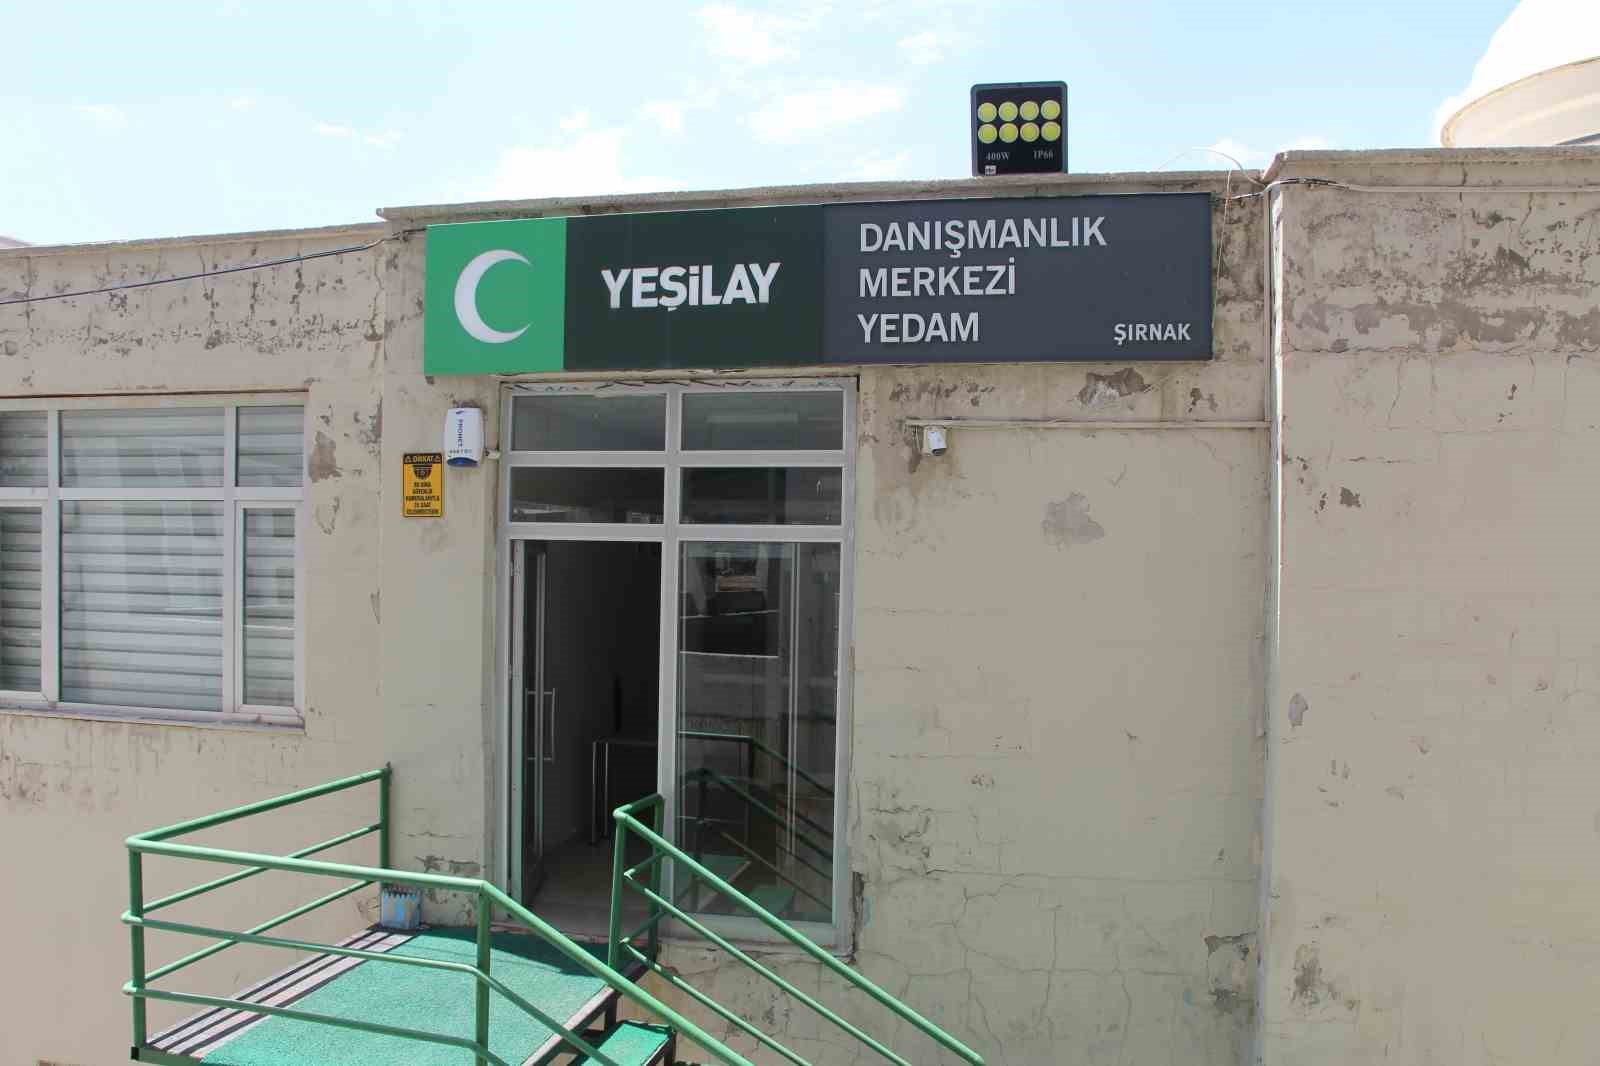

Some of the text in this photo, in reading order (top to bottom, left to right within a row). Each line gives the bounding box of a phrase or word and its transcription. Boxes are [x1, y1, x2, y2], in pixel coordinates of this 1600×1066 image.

[985, 151, 1010, 161] 400W
[859, 216, 1108, 258] DANIŞMANLIK
[600, 262, 782, 313] YEŞİLAY
[858, 256, 1017, 298] MERKEZİ
[856, 311, 980, 344] YEDAM
[1113, 323, 1192, 346] ŞIRNAK
